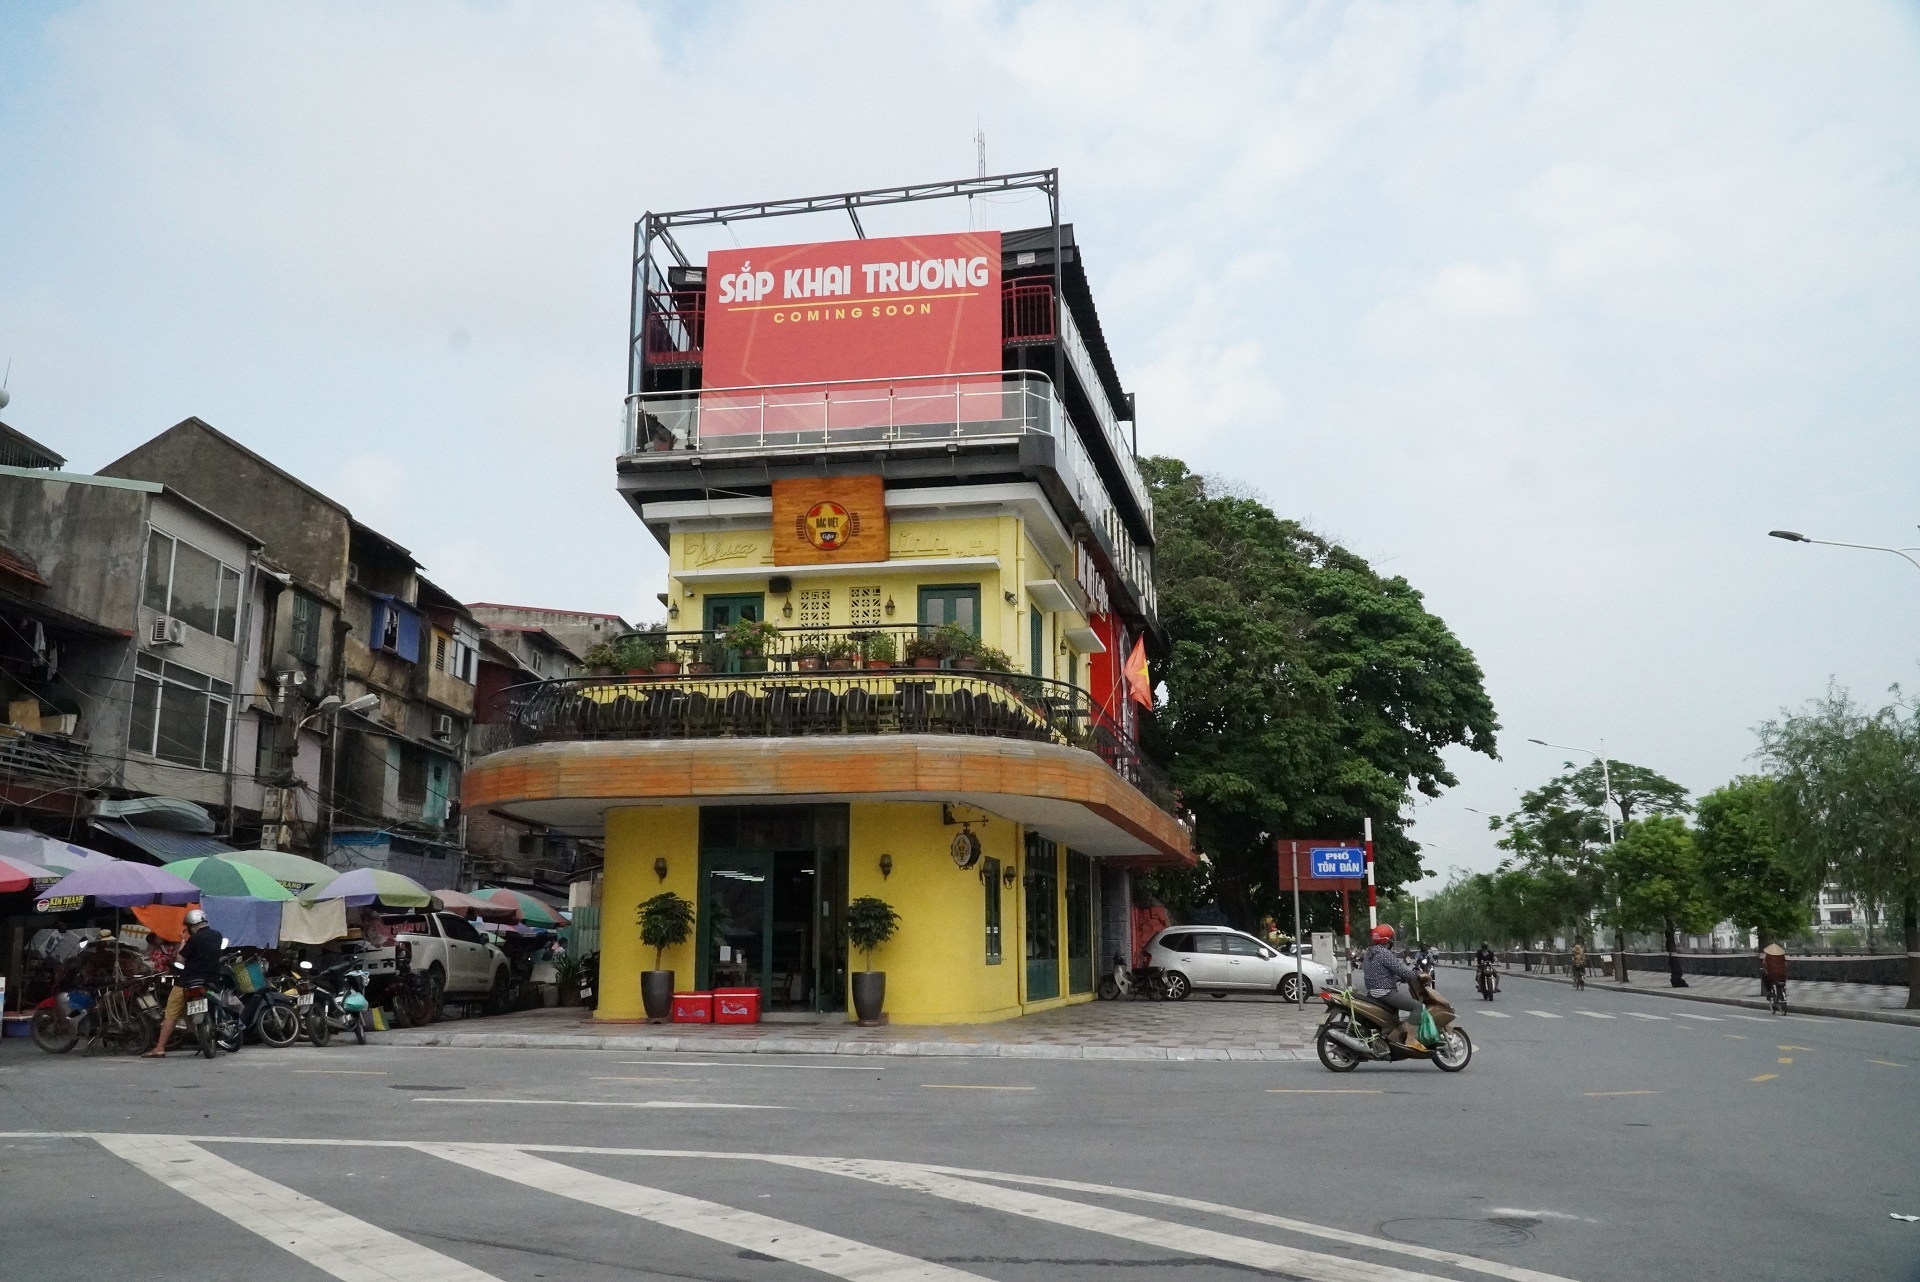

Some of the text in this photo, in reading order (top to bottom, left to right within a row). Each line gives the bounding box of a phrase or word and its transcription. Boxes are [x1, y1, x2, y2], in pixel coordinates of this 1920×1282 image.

[719, 257, 988, 303] SẮP KHAI TRƯƠNG
[774, 303, 931, 323] COMING SOON
[1326, 851, 1349, 860] PHỐ
[1317, 859, 1360, 872] TÔN ĐẢN
